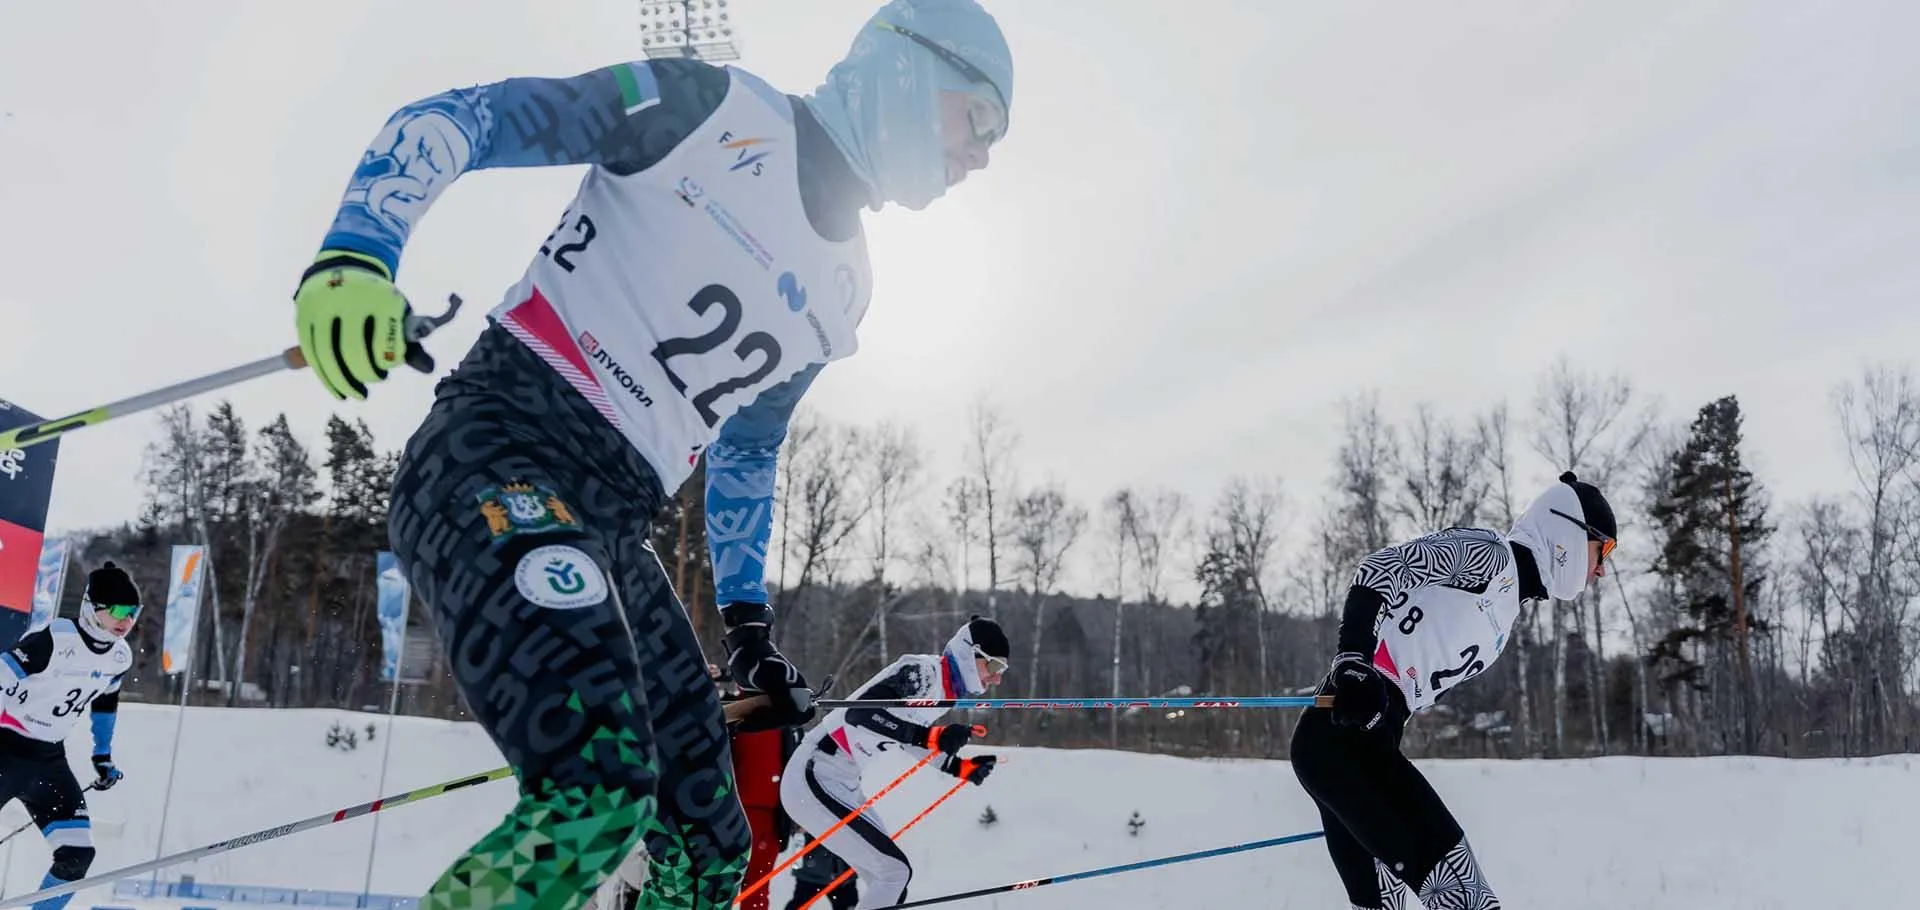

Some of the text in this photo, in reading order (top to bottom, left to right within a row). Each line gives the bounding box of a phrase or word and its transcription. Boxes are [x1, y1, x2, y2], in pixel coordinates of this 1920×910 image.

[718, 131, 764, 177] FIS
[592, 348, 654, 408] ЛУКОЙЛ
[651, 283, 782, 429] 22
[52, 687, 98, 718] 34
